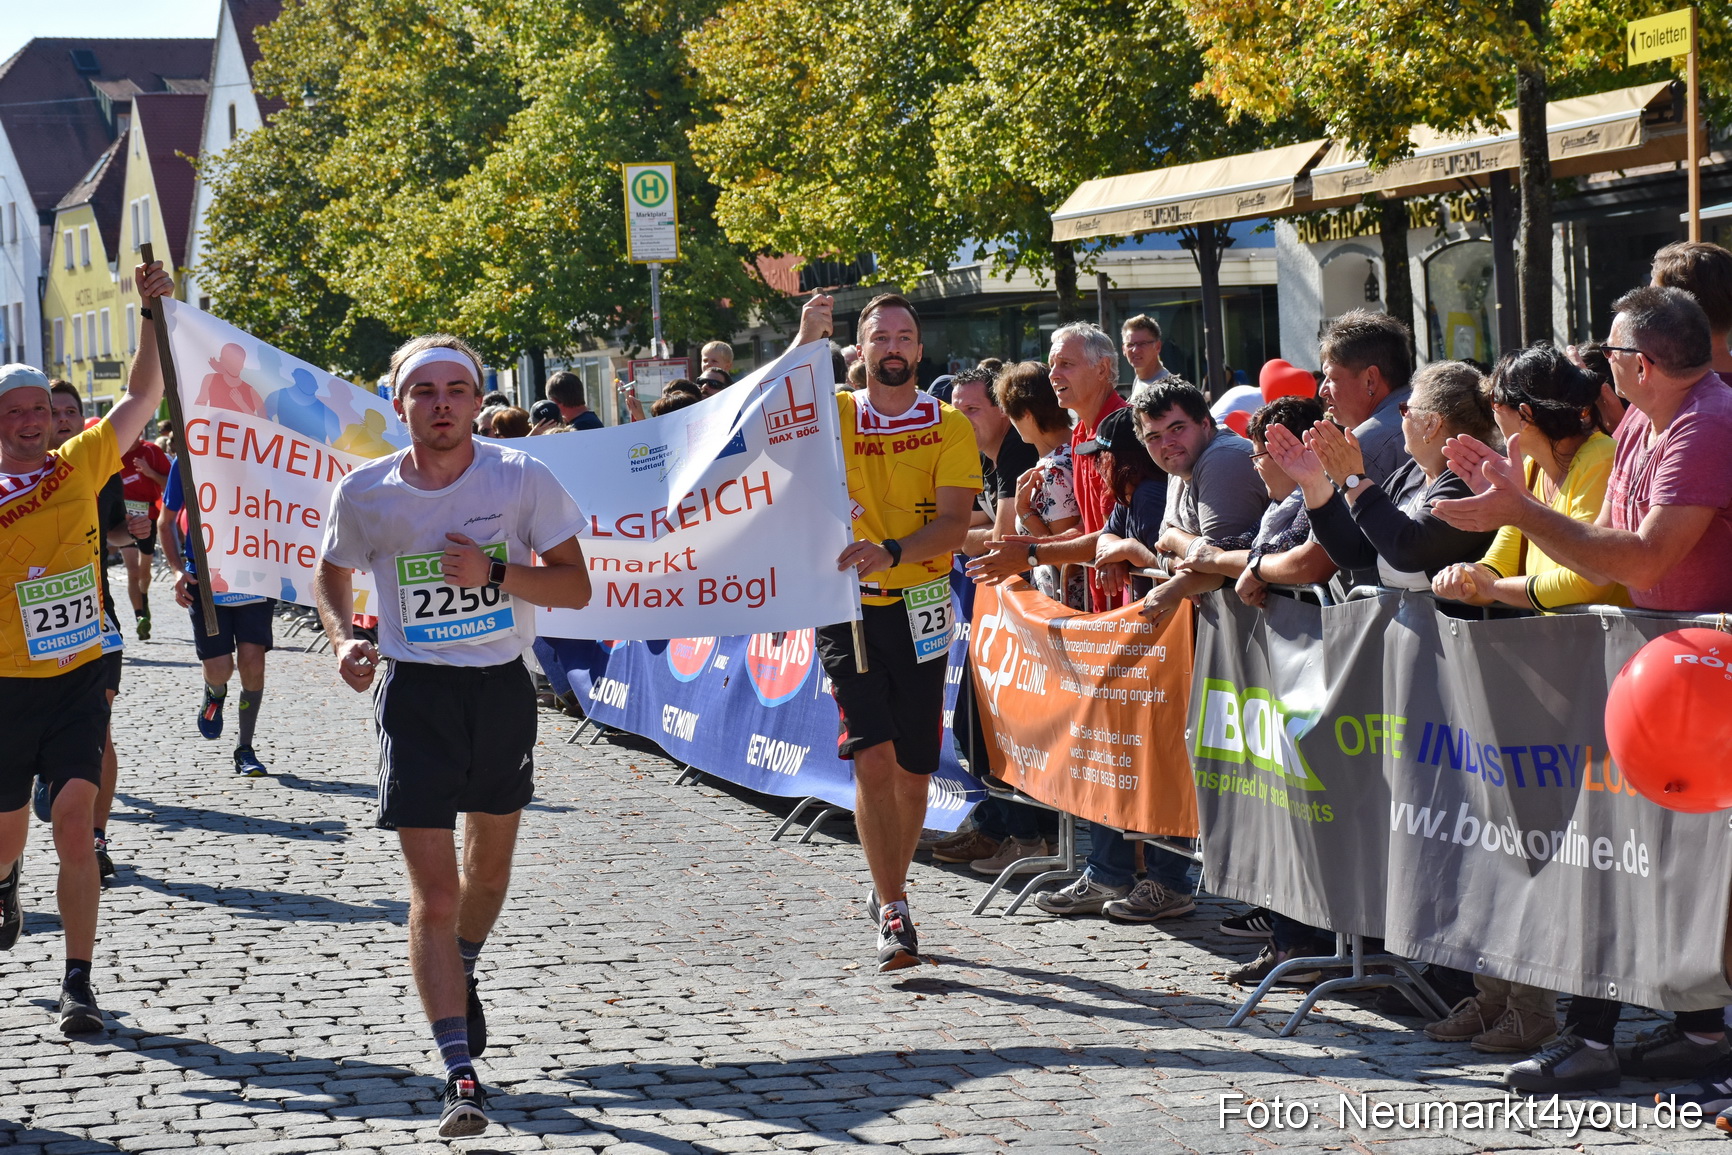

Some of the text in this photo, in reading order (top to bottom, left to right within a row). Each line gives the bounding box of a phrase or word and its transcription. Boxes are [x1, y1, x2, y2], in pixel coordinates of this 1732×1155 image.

[1640, 26, 1687, 50] Toiletten
[636, 211, 667, 219] Marktplatz
[769, 426, 819, 446] MAX BÖGL
[854, 431, 943, 456] MAX BÖGL
[630, 445, 649, 459] 20
[630, 450, 673, 466] Neumarkter
[630, 459, 666, 473] Stadtlauf
[0, 495, 42, 529] MAX
[229, 486, 321, 529] Jahre
[226, 526, 316, 568] Jahre
[26, 568, 92, 602] BOCK
[606, 567, 776, 608] Max Bögl
[33, 594, 94, 633] 2373
[413, 587, 500, 619] 2250
[37, 624, 97, 651] CHRISTIAN
[424, 616, 496, 640] THOMAS
[1119, 618, 1153, 634] Partner
[1096, 639, 1111, 655] und
[1111, 641, 1167, 662] Umsetzung
[1016, 658, 1048, 696] CLINIC
[1090, 665, 1105, 677] was
[1107, 663, 1150, 680] Internet,
[1130, 687, 1168, 707] angeht.
[1080, 724, 1093, 740] Sie
[1106, 728, 1120, 745] bei
[746, 733, 767, 768] GET
[1086, 747, 1132, 768] codeclinic.de
[1118, 774, 1139, 791] 897
[1193, 764, 1256, 796] inspired
[1259, 776, 1268, 806] by
